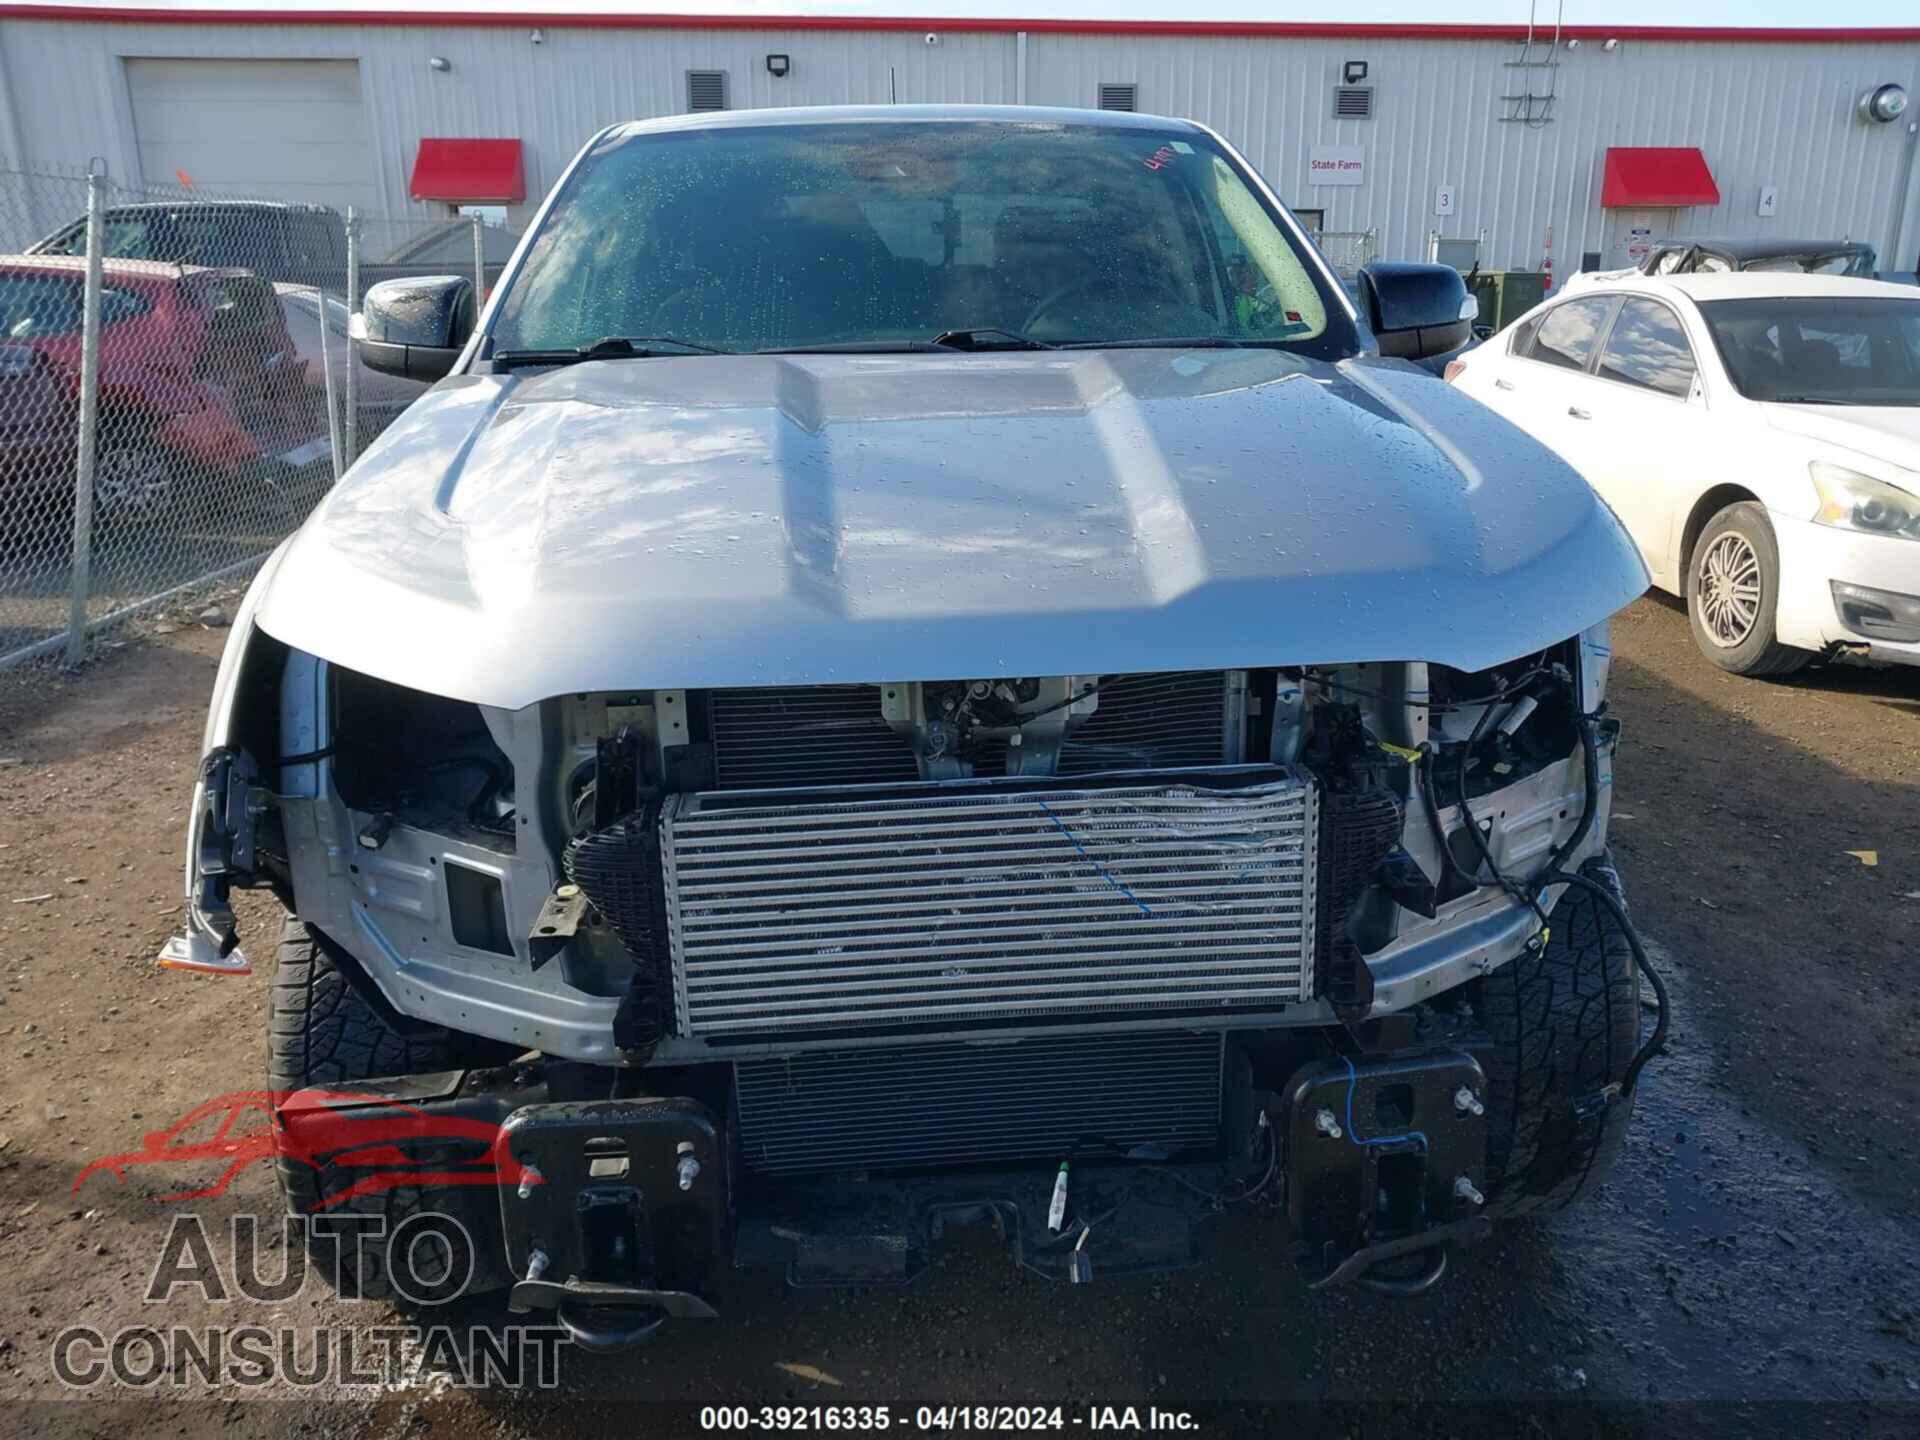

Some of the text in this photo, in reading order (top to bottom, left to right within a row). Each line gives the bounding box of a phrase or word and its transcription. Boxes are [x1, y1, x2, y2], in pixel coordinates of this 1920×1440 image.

[1311, 159, 1362, 170] State Farm
[1440, 193, 1449, 207] 3
[1764, 194, 1773, 208] 4
